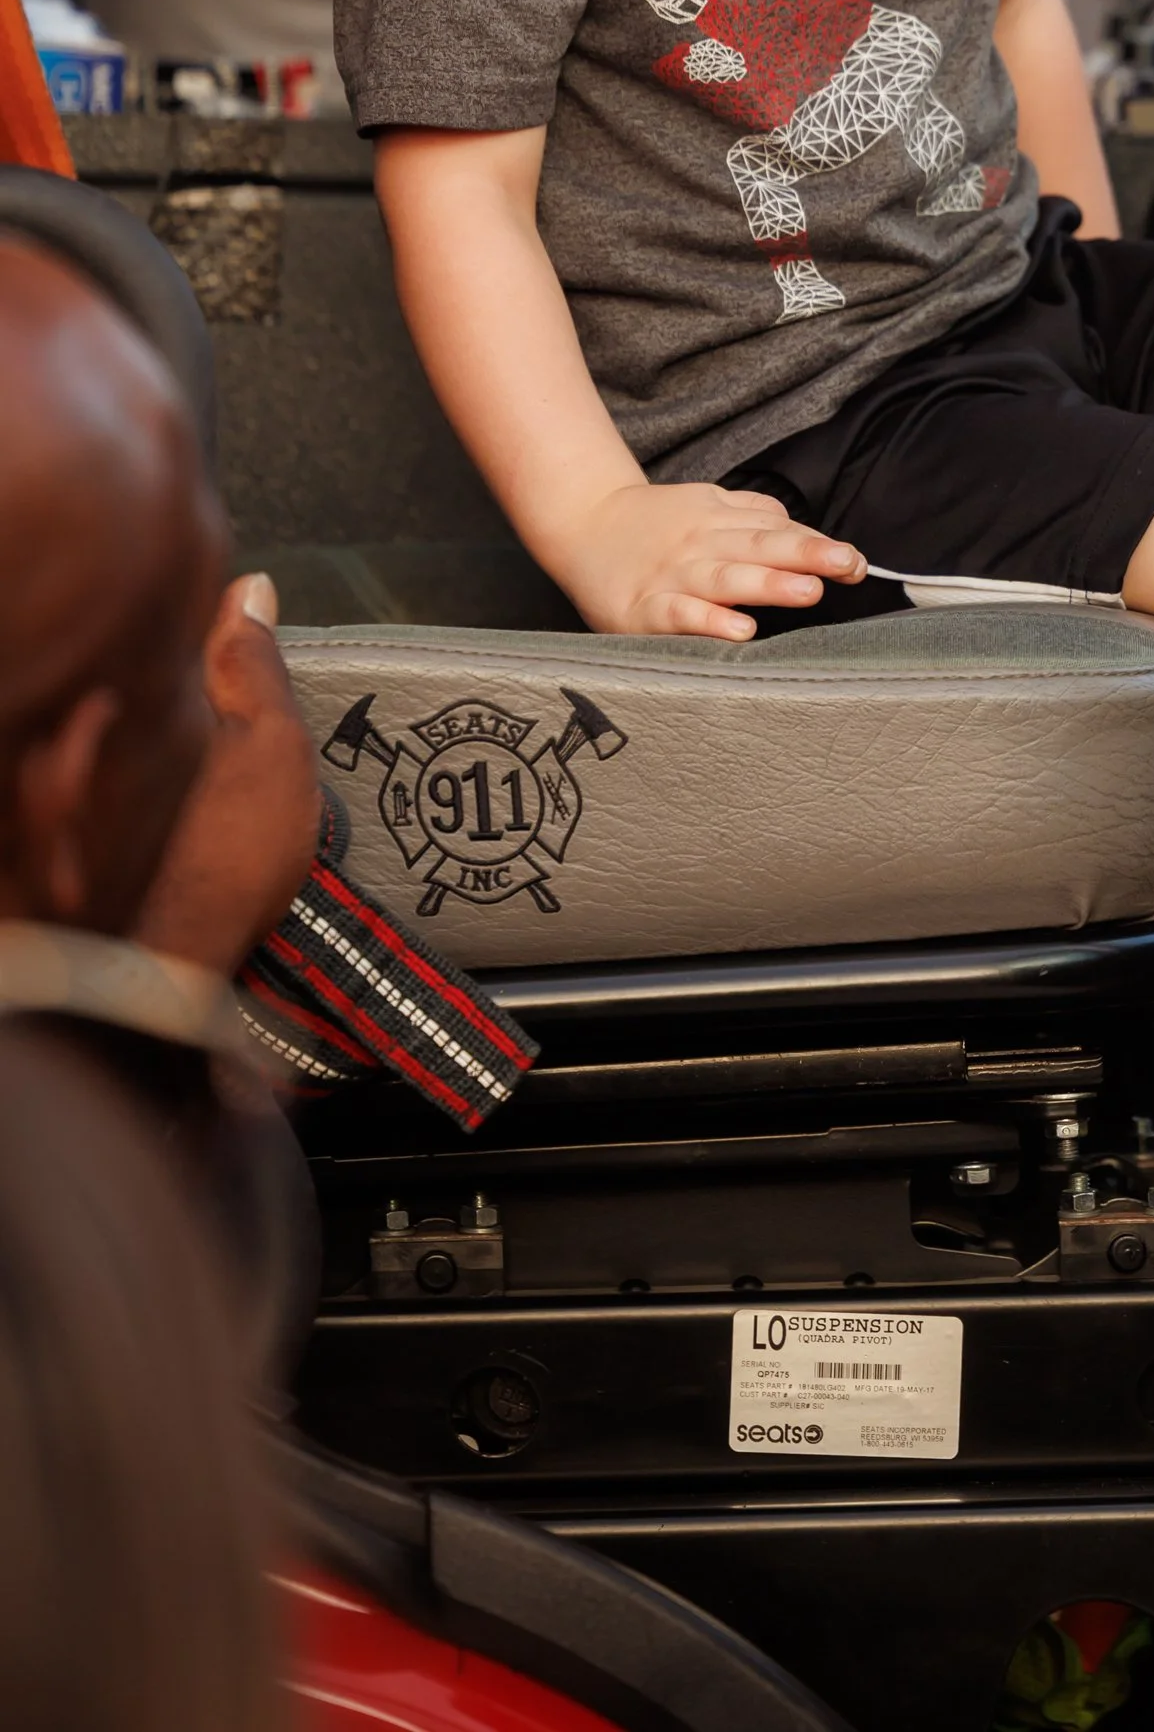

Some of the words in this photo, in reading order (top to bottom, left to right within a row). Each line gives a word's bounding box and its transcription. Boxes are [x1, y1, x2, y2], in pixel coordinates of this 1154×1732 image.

[426, 712, 522, 747] SEATS
[428, 761, 532, 842] 911
[456, 867, 513, 892] INC
[753, 1315, 787, 1351] LO
[788, 1316, 924, 1335] SUSPENSION
[798, 1334, 845, 1344] (QUADRA
[852, 1335, 893, 1345] PIVOT)
[741, 1360, 767, 1368] SERIAL
[757, 1370, 790, 1379] QP7475
[740, 1381, 764, 1389] SEATS
[766, 1382, 787, 1390] PART
[854, 1384, 872, 1392] MFG
[896, 1386, 935, 1394] 19-MAY-17
[739, 1390, 760, 1398] CUST
[761, 1391, 782, 1399] PART
[736, 1423, 802, 1444] seats
[860, 1425, 885, 1434] SEATS
[887, 1427, 947, 1436] INCORPORATED
